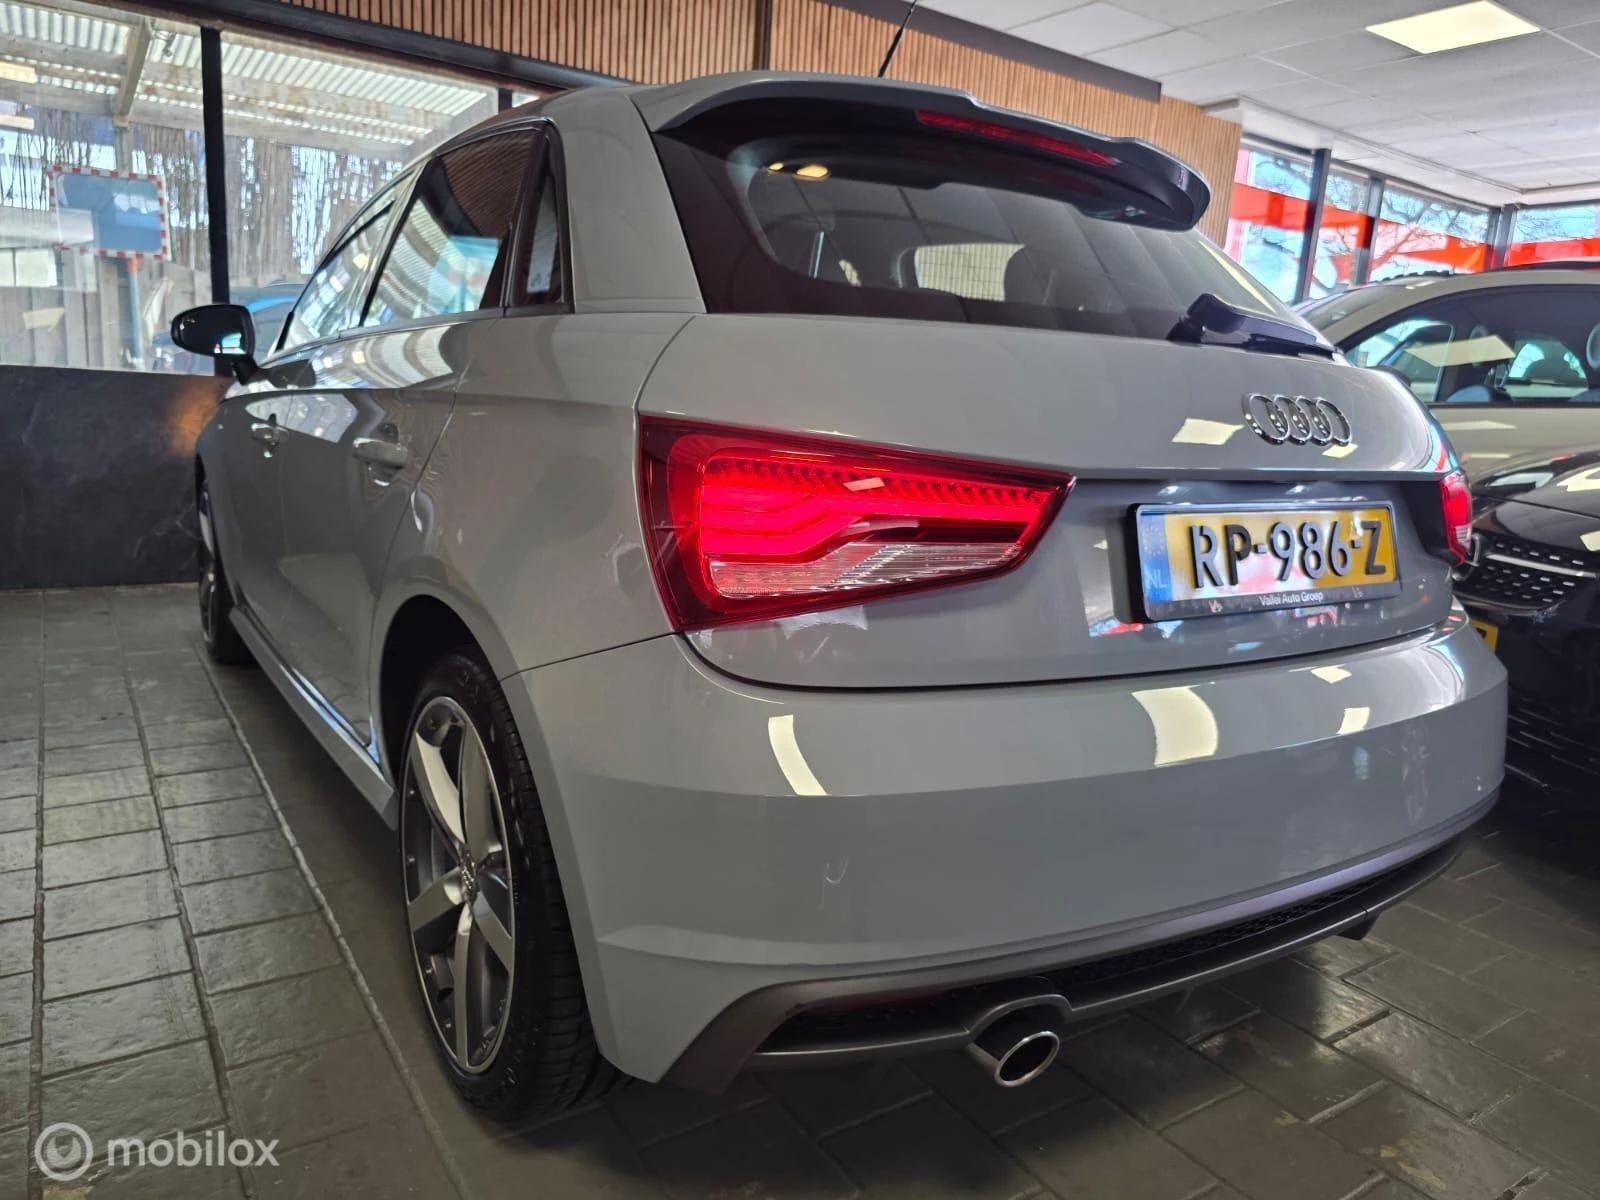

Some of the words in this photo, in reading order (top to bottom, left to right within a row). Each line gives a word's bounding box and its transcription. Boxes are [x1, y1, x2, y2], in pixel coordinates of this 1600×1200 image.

[1189, 520, 1387, 589] RP-986-Z
[1143, 564, 1168, 590] NL
[1282, 592, 1300, 604] Auto
[1300, 591, 1324, 603] Groep
